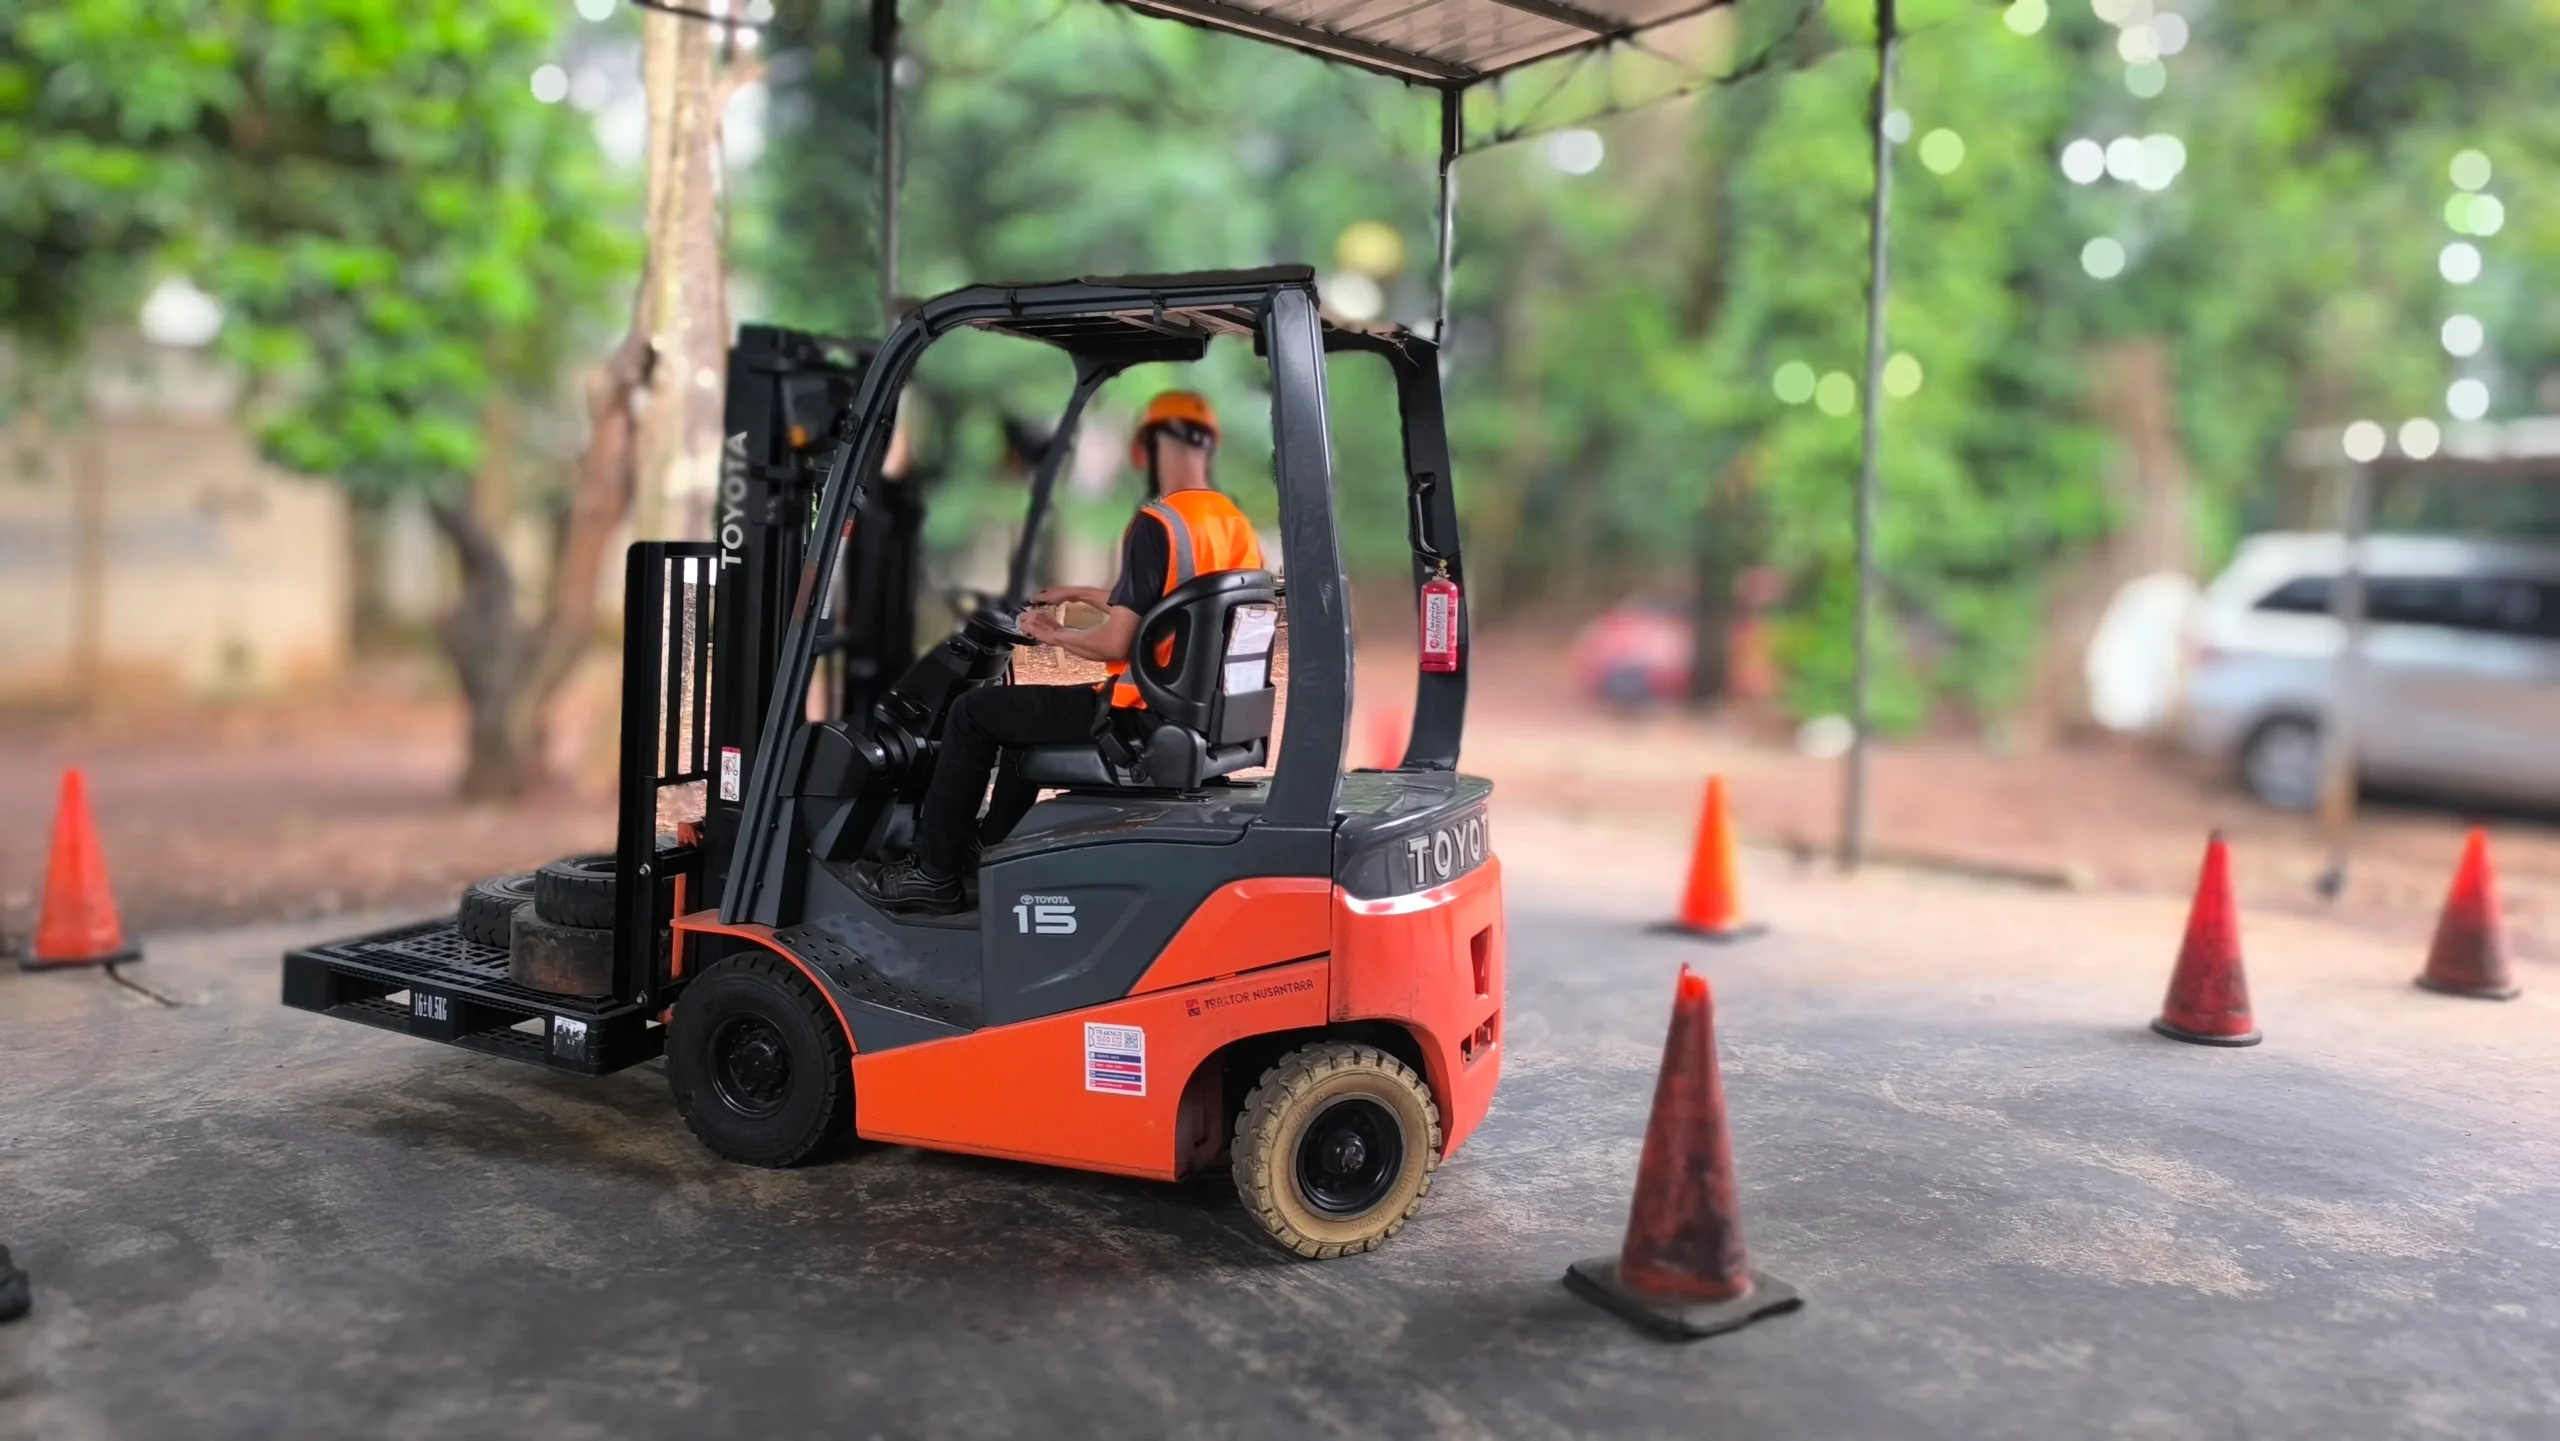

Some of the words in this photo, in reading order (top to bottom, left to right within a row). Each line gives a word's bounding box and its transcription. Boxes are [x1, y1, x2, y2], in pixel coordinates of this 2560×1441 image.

[721, 431, 748, 570] TOYOTA
[1034, 896, 1070, 904] TOYOTA
[1012, 905, 1077, 934] 15
[1252, 979, 1314, 1000] NUSANTARA
